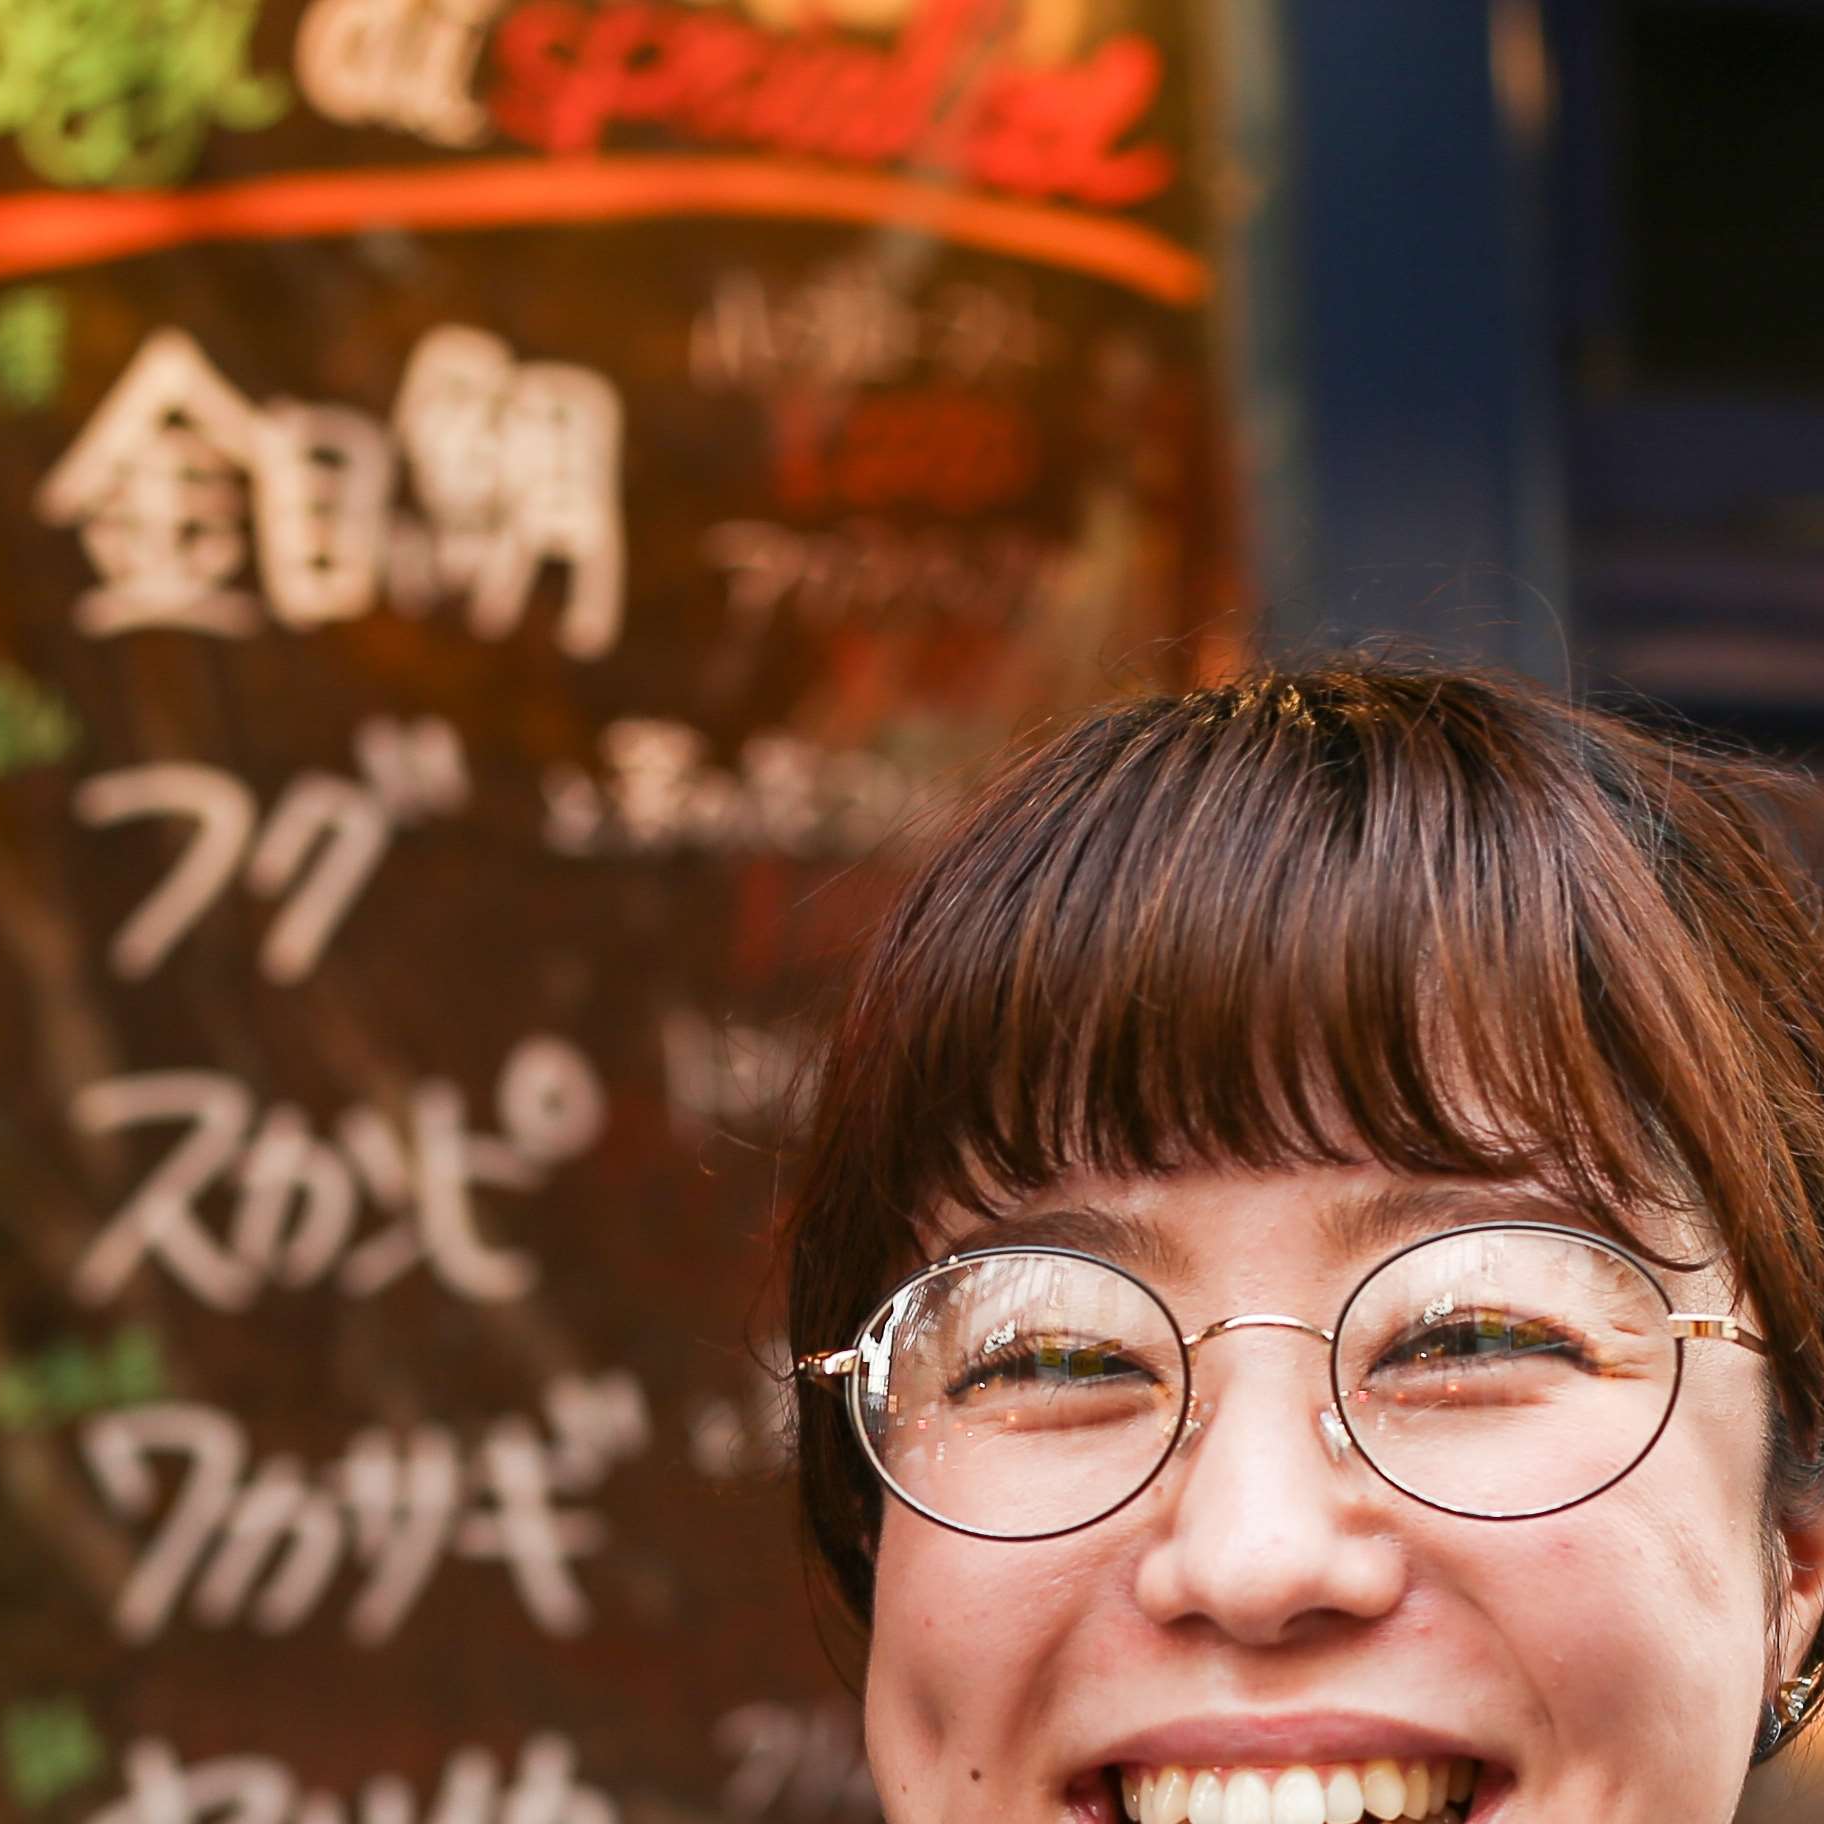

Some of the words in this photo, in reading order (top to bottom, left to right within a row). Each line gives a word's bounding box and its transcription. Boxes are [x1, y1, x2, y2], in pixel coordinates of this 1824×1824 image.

[38, 325, 624, 656] 金目鯛
[76, 716, 470, 984] フグ
[74, 1036, 606, 1308] スカンピ
[82, 1370, 650, 1644] ワカサギ
